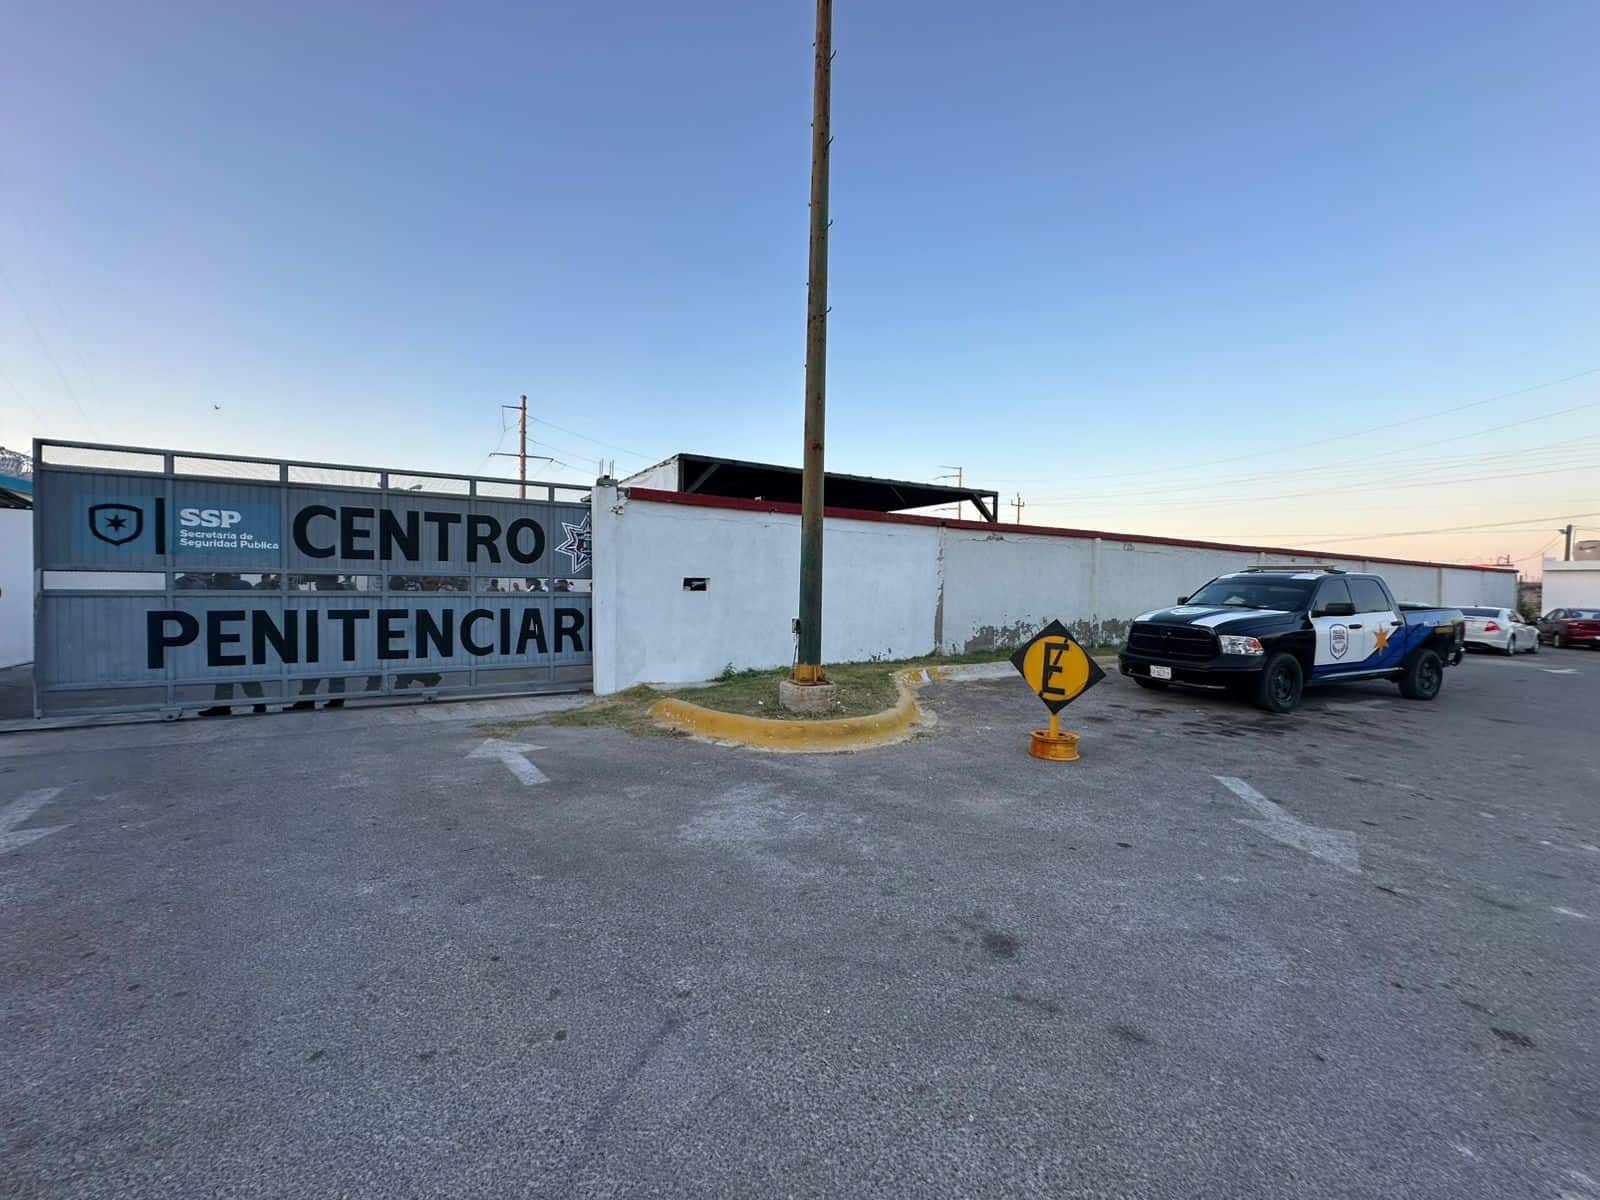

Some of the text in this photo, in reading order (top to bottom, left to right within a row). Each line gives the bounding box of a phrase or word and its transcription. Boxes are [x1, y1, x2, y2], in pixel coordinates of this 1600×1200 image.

[180, 508, 242, 528] SSP
[179, 538, 238, 548] Seguridad
[239, 532, 254, 540] de
[293, 504, 546, 565] CENTRO
[147, 607, 592, 669] PENITENCIAR
